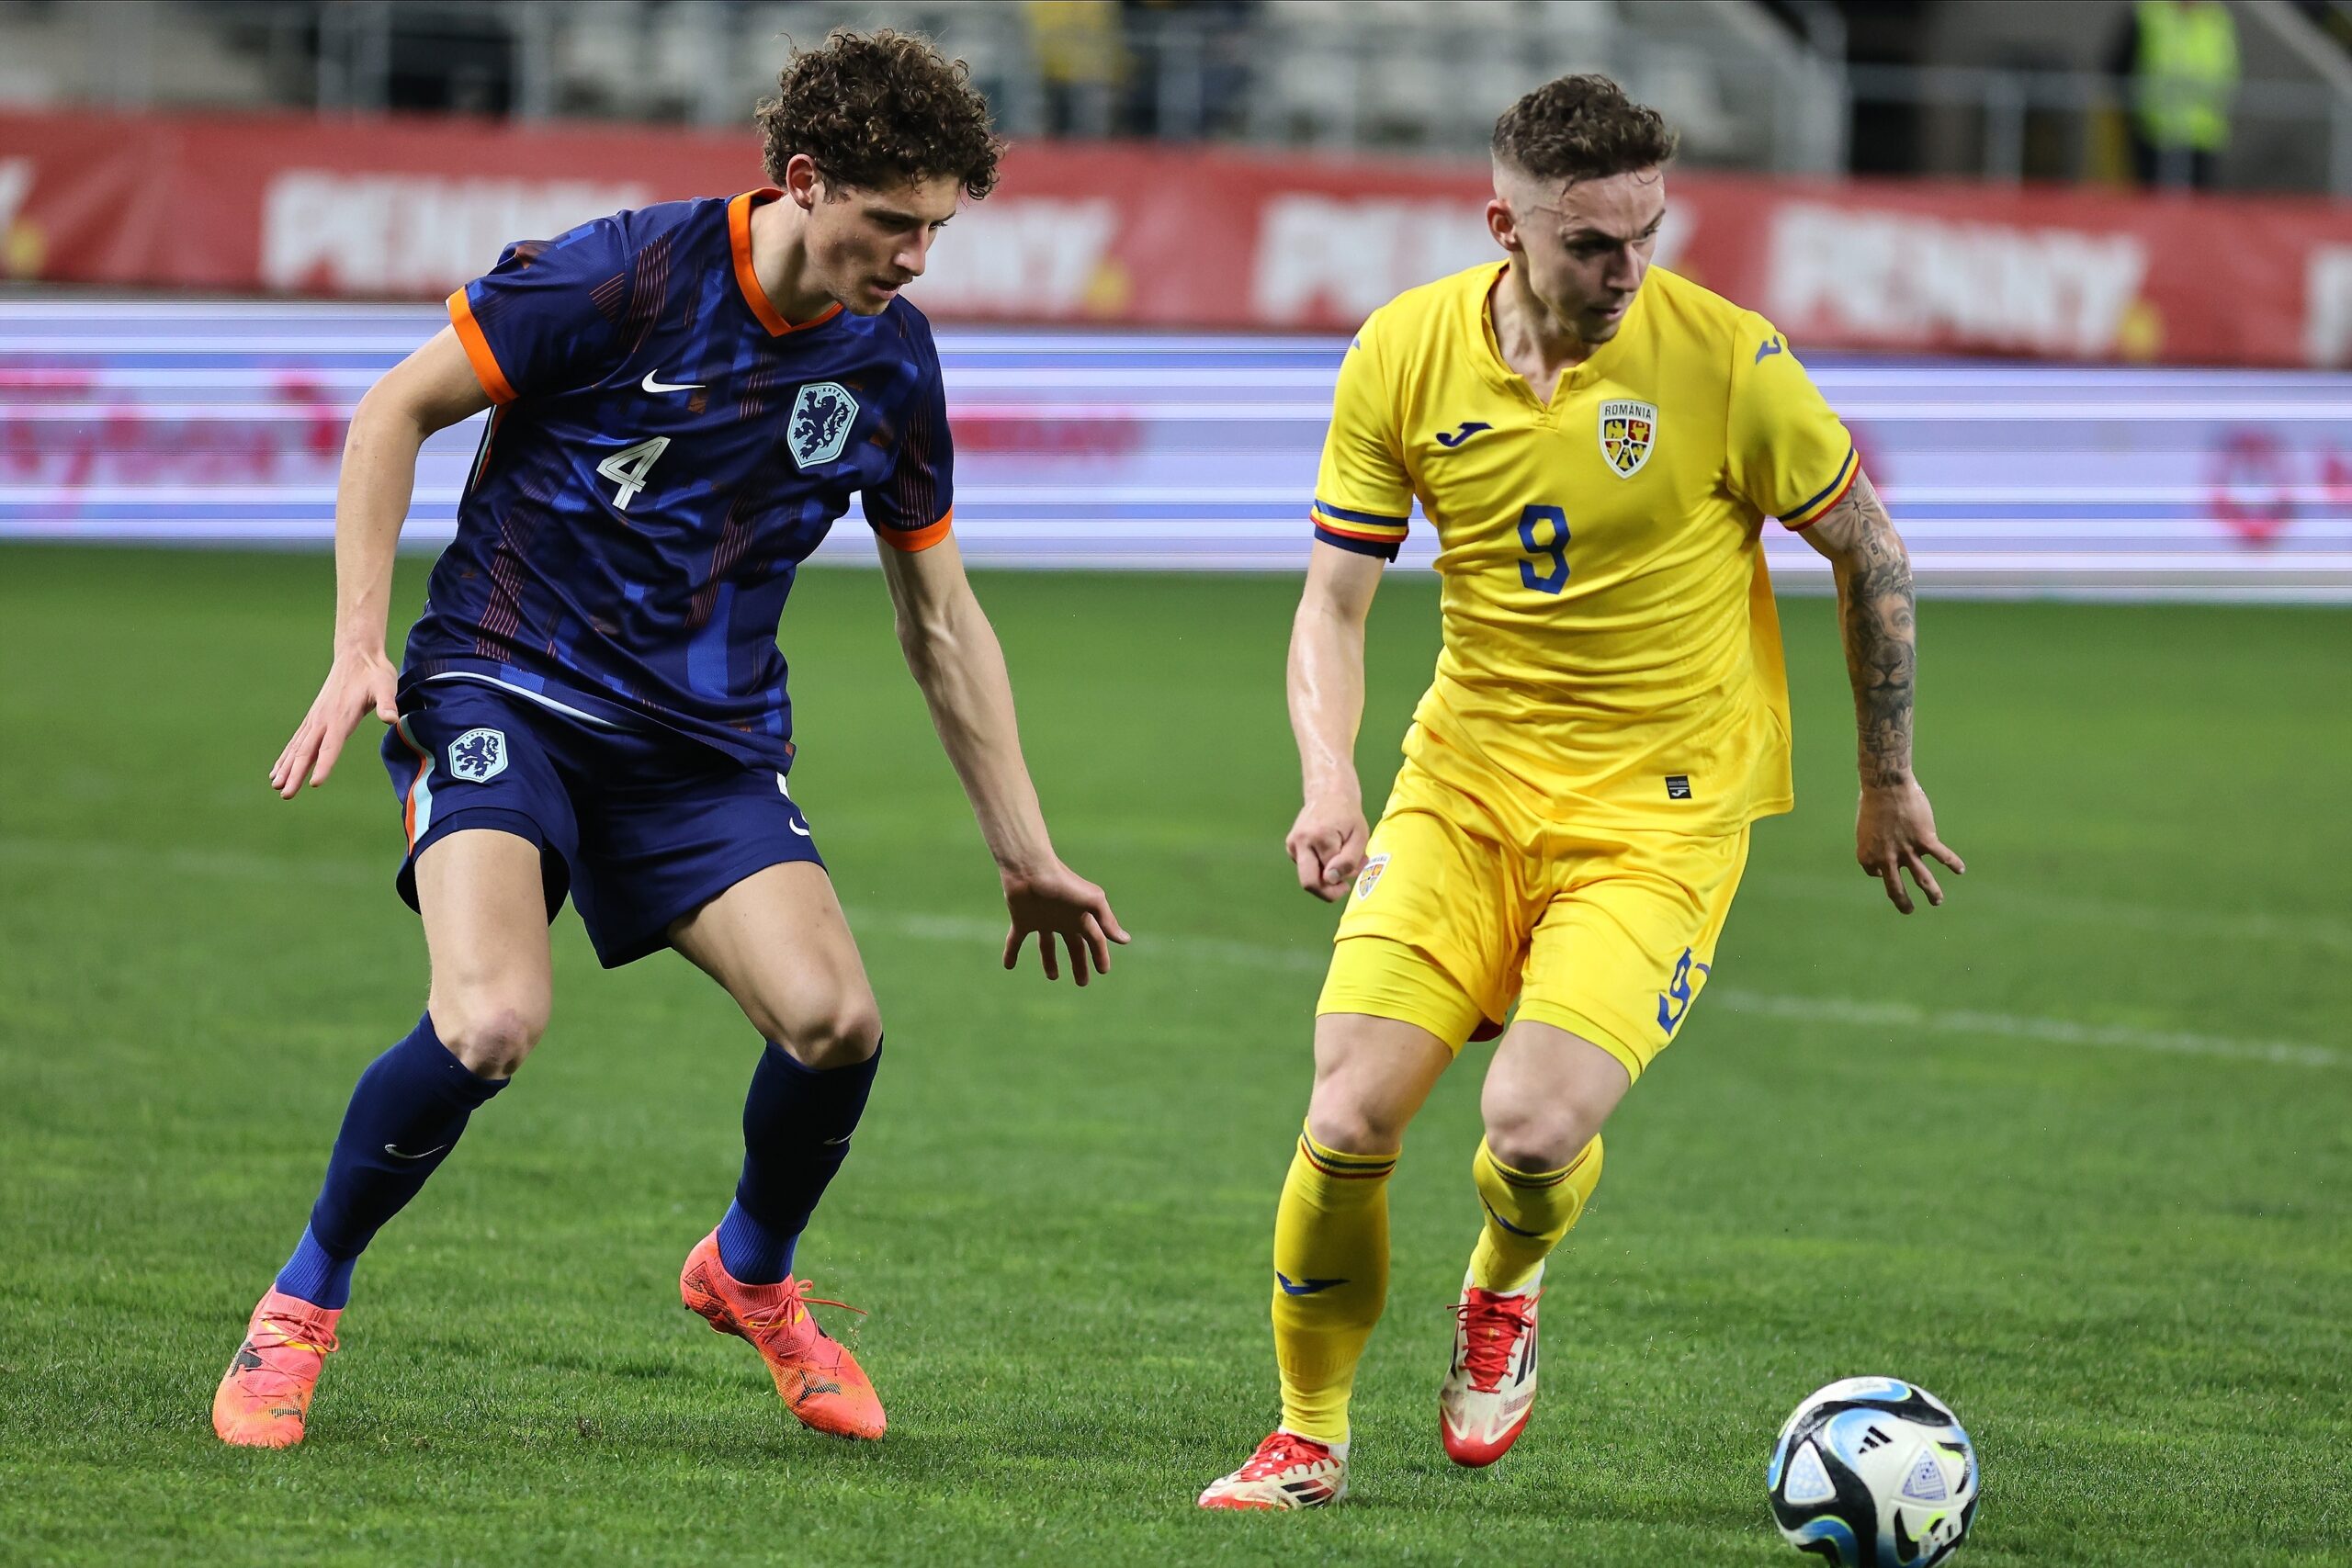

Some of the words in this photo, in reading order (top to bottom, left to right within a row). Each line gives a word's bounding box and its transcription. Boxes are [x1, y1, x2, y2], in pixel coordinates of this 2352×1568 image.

[595, 435, 672, 511] 4
[1517, 503, 1571, 595] 9
[1657, 945, 1691, 1037] 9
